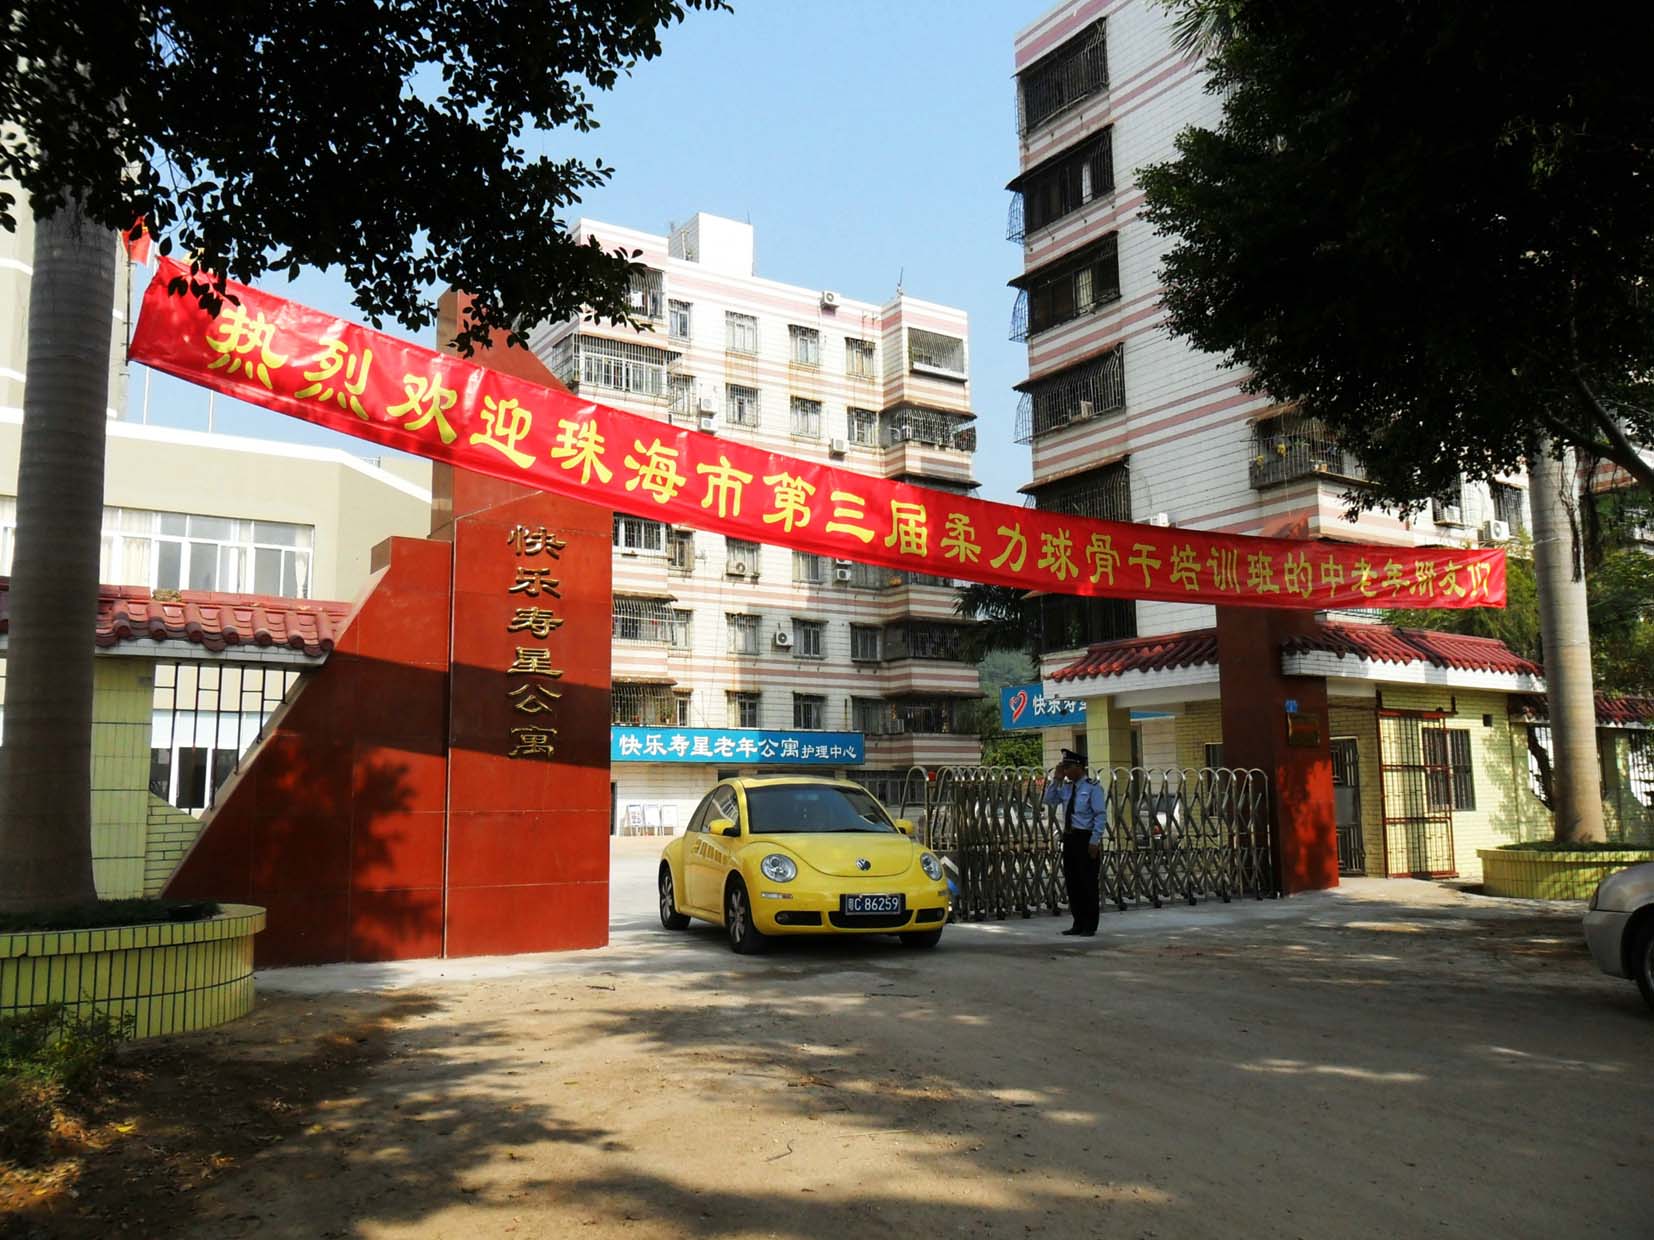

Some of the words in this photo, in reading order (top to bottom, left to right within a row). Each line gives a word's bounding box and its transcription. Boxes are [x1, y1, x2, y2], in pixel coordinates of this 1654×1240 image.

[507, 524, 567, 757] 快乐寿星公寓
